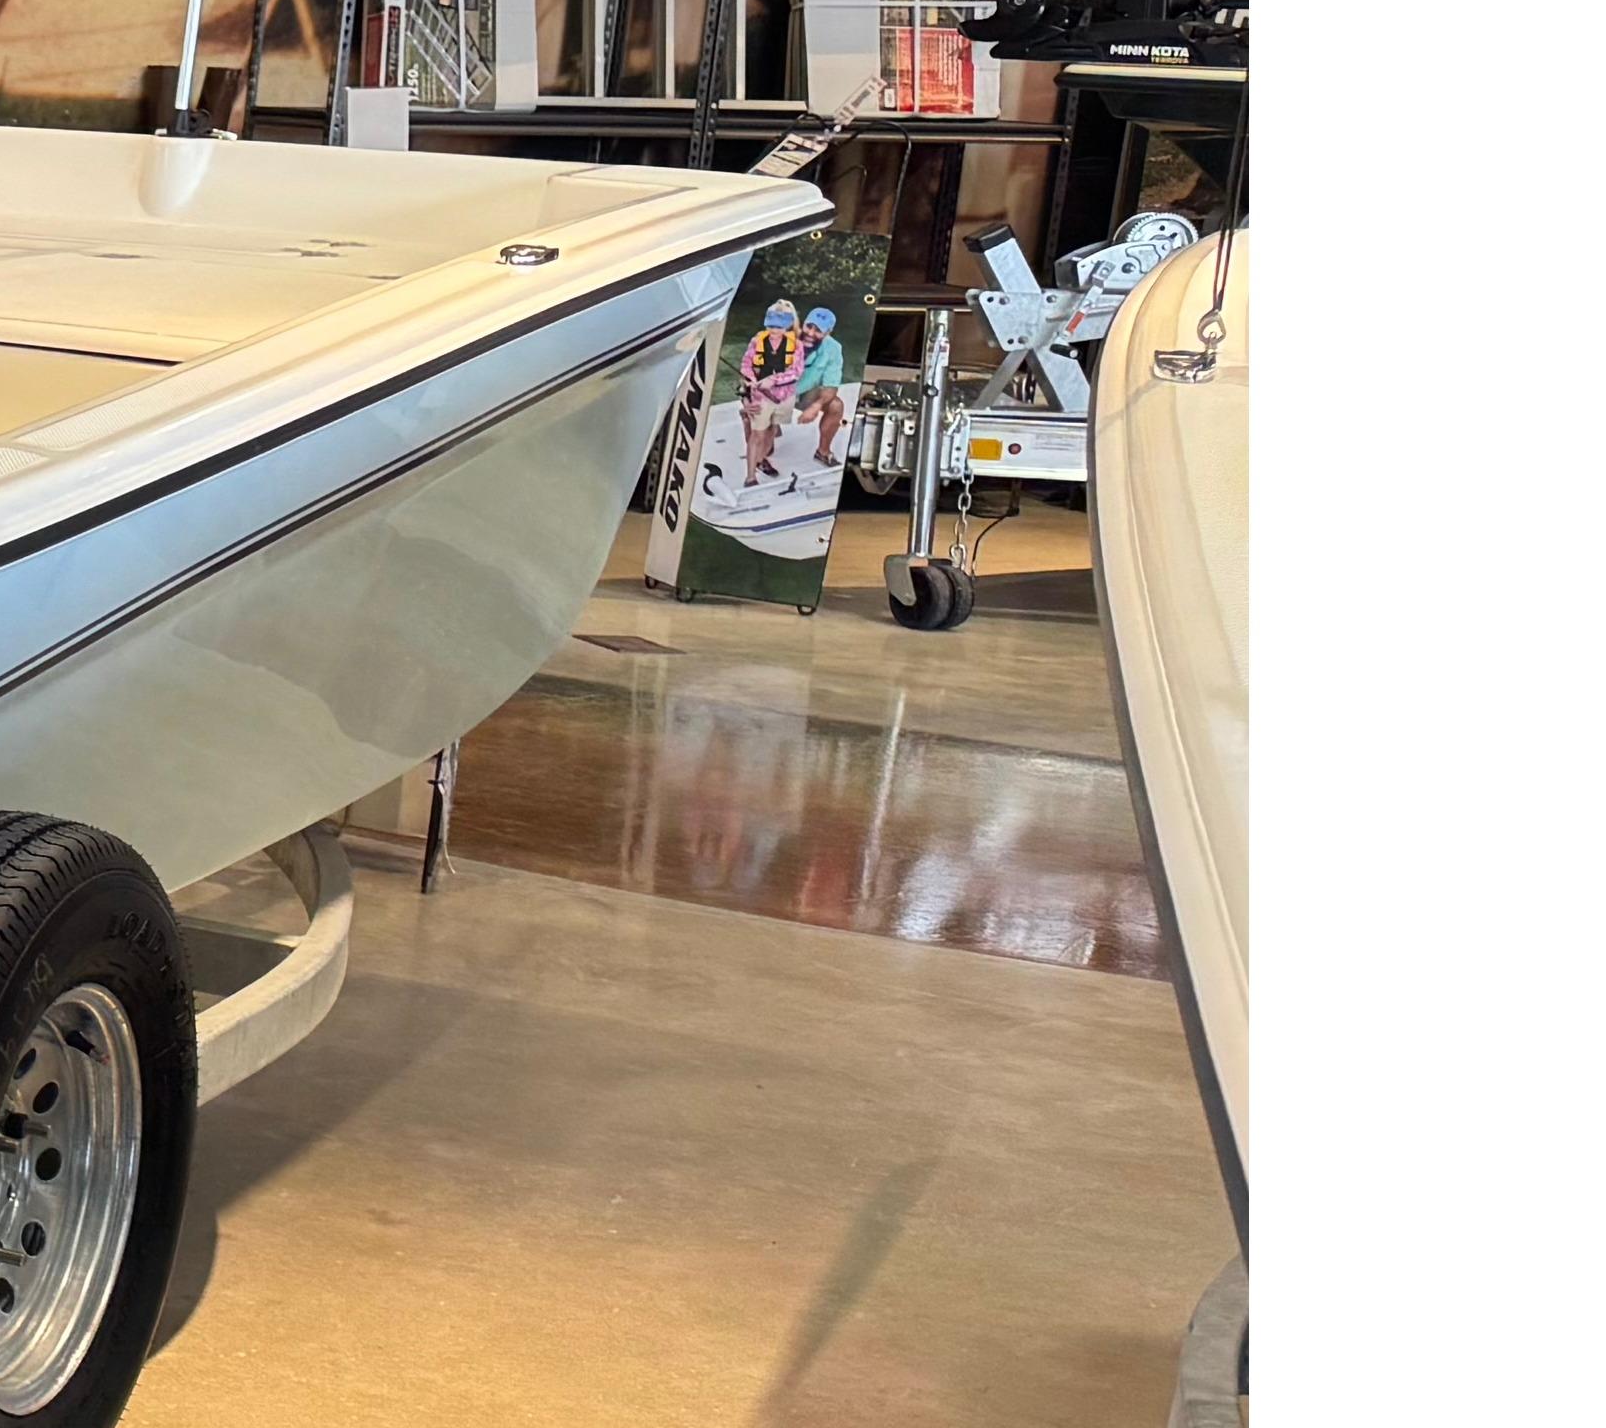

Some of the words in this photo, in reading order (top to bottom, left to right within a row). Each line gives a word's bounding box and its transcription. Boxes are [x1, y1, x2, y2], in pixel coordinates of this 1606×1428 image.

[1110, 44, 1150, 57] MINN
[1150, 45, 1190, 58] KOTA
[660, 357, 705, 534] MAKO
